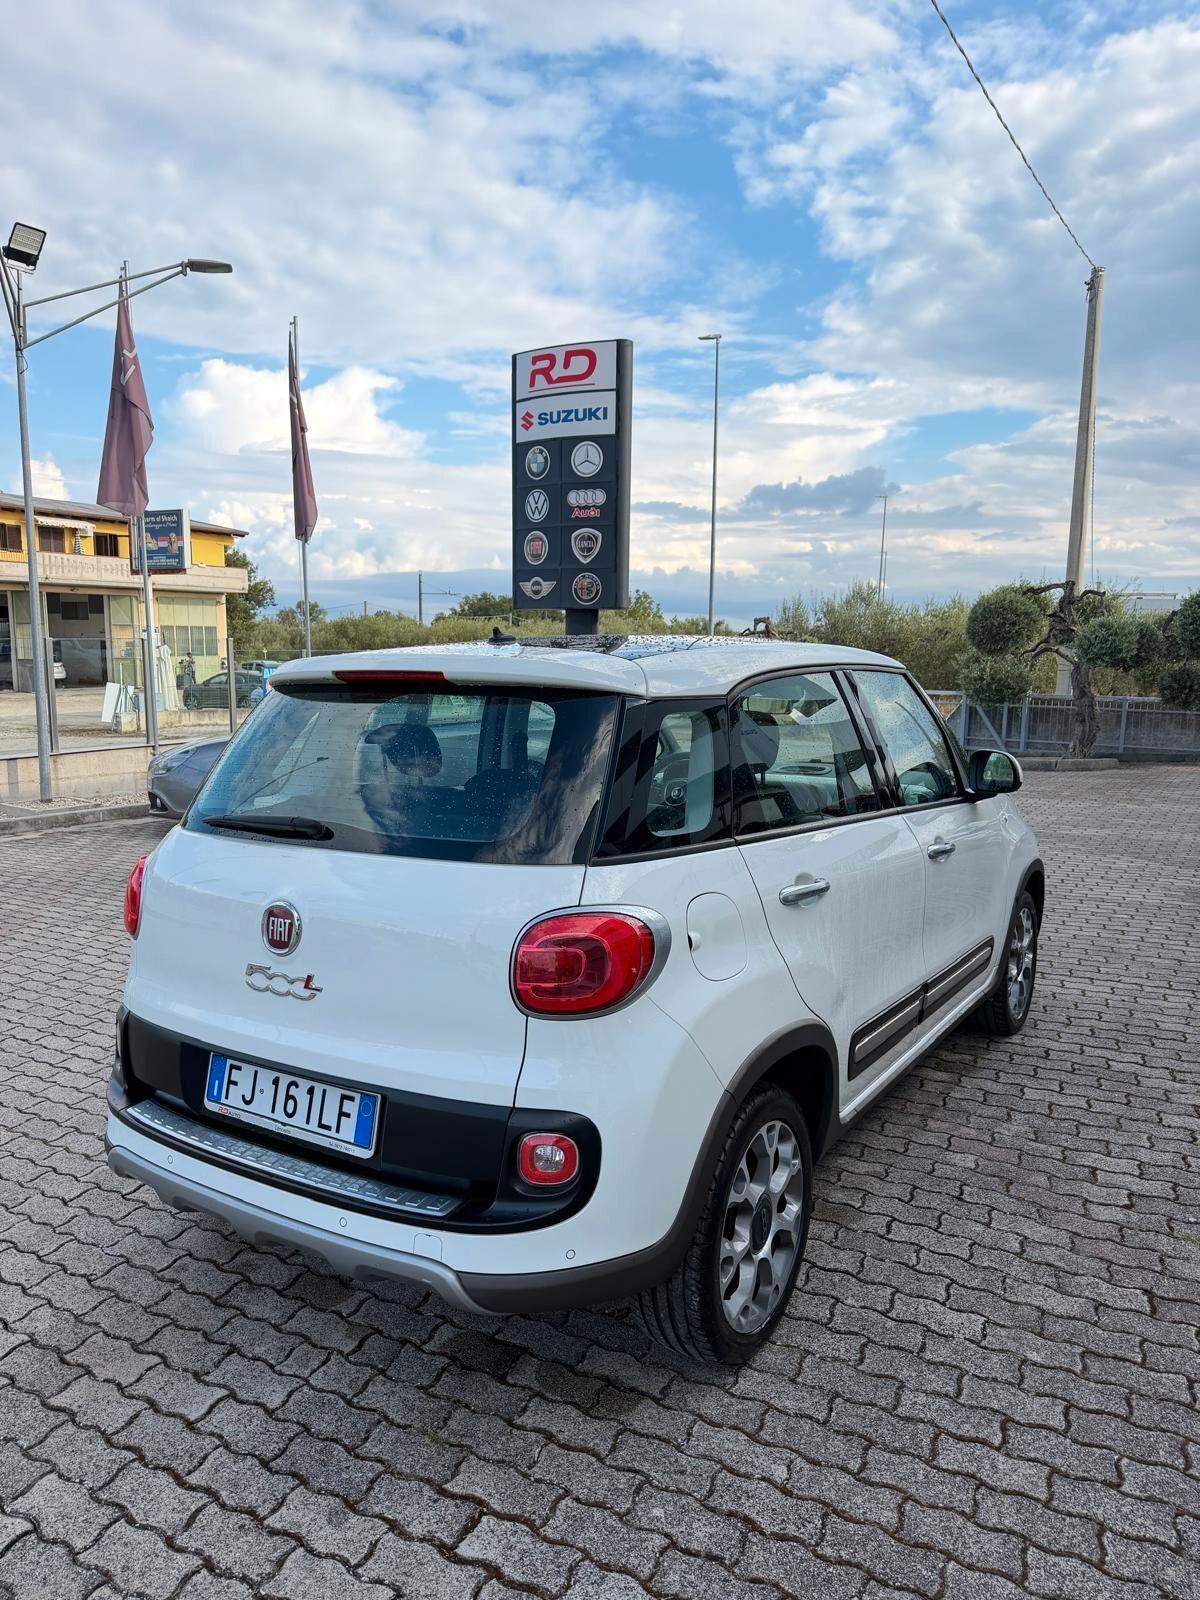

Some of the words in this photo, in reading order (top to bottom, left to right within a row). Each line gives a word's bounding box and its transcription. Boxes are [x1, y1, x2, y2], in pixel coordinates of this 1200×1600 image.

[528, 348, 597, 388] RD
[537, 406, 608, 426] SUZUKI
[268, 916, 292, 942] FIAT
[245, 961, 323, 1001] 500L
